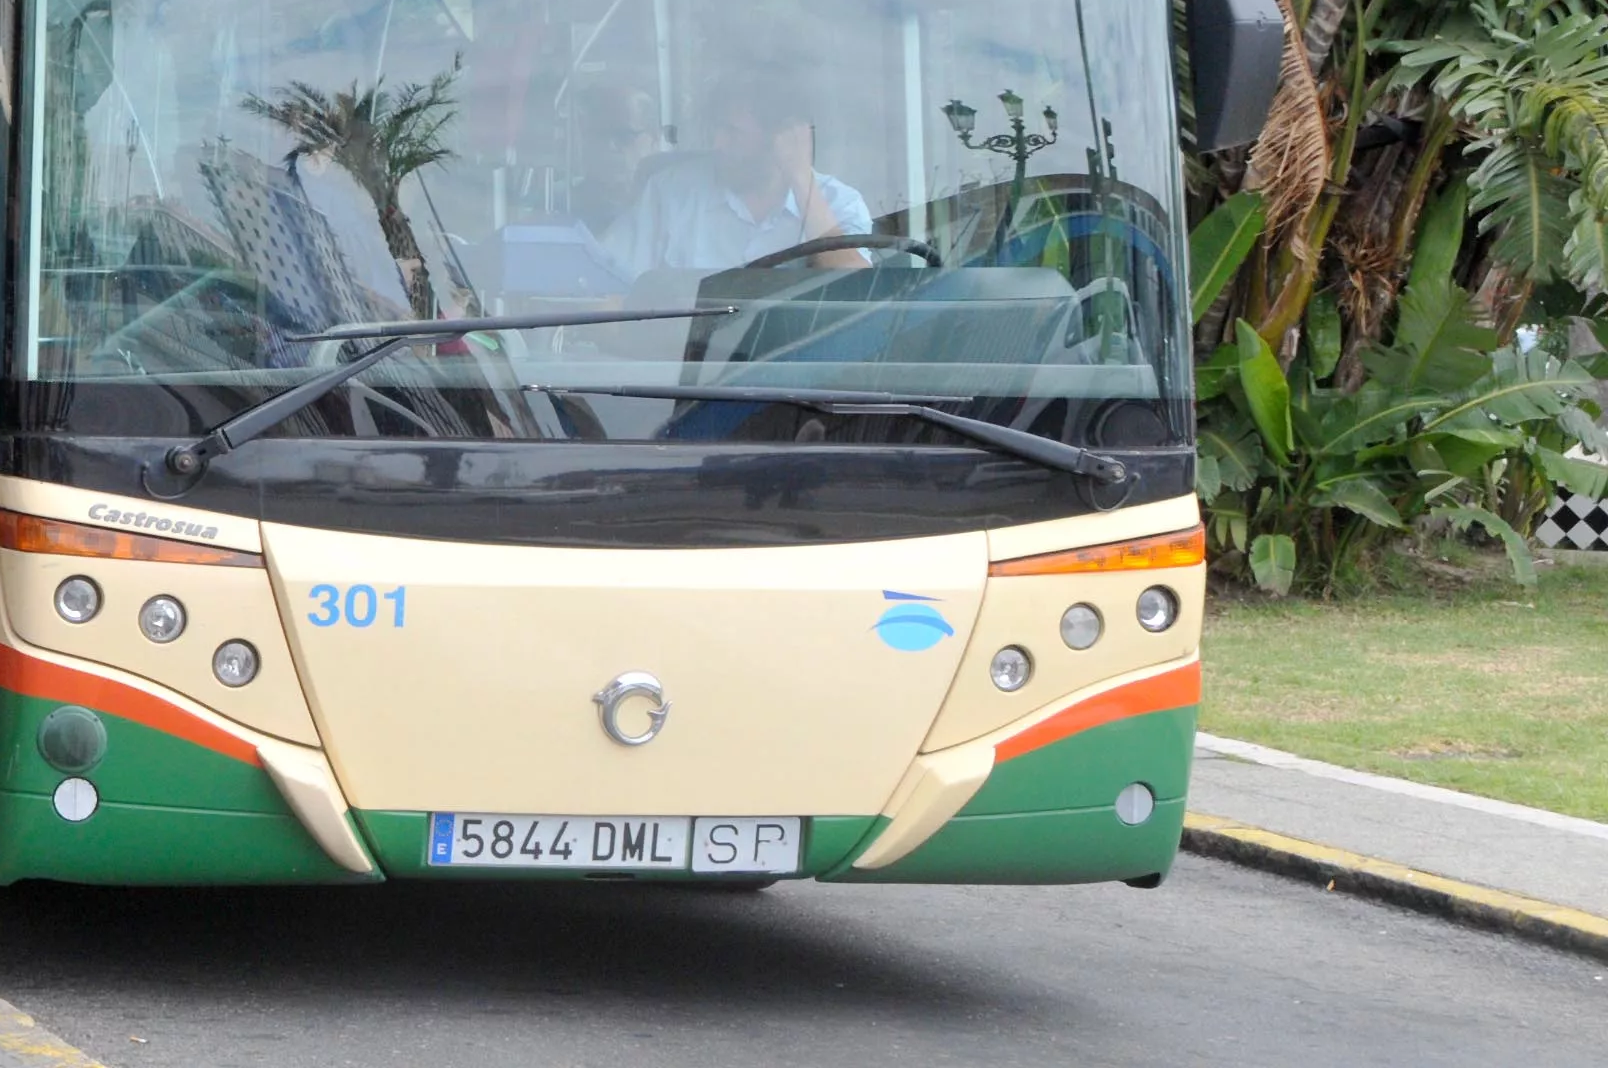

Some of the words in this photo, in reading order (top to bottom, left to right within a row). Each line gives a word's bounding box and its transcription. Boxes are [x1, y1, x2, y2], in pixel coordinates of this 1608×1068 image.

[88, 503, 219, 540] Castrosua
[307, 584, 407, 628] 301
[436, 843, 448, 855] E
[462, 819, 572, 860] 5844
[592, 822, 673, 862] DML
